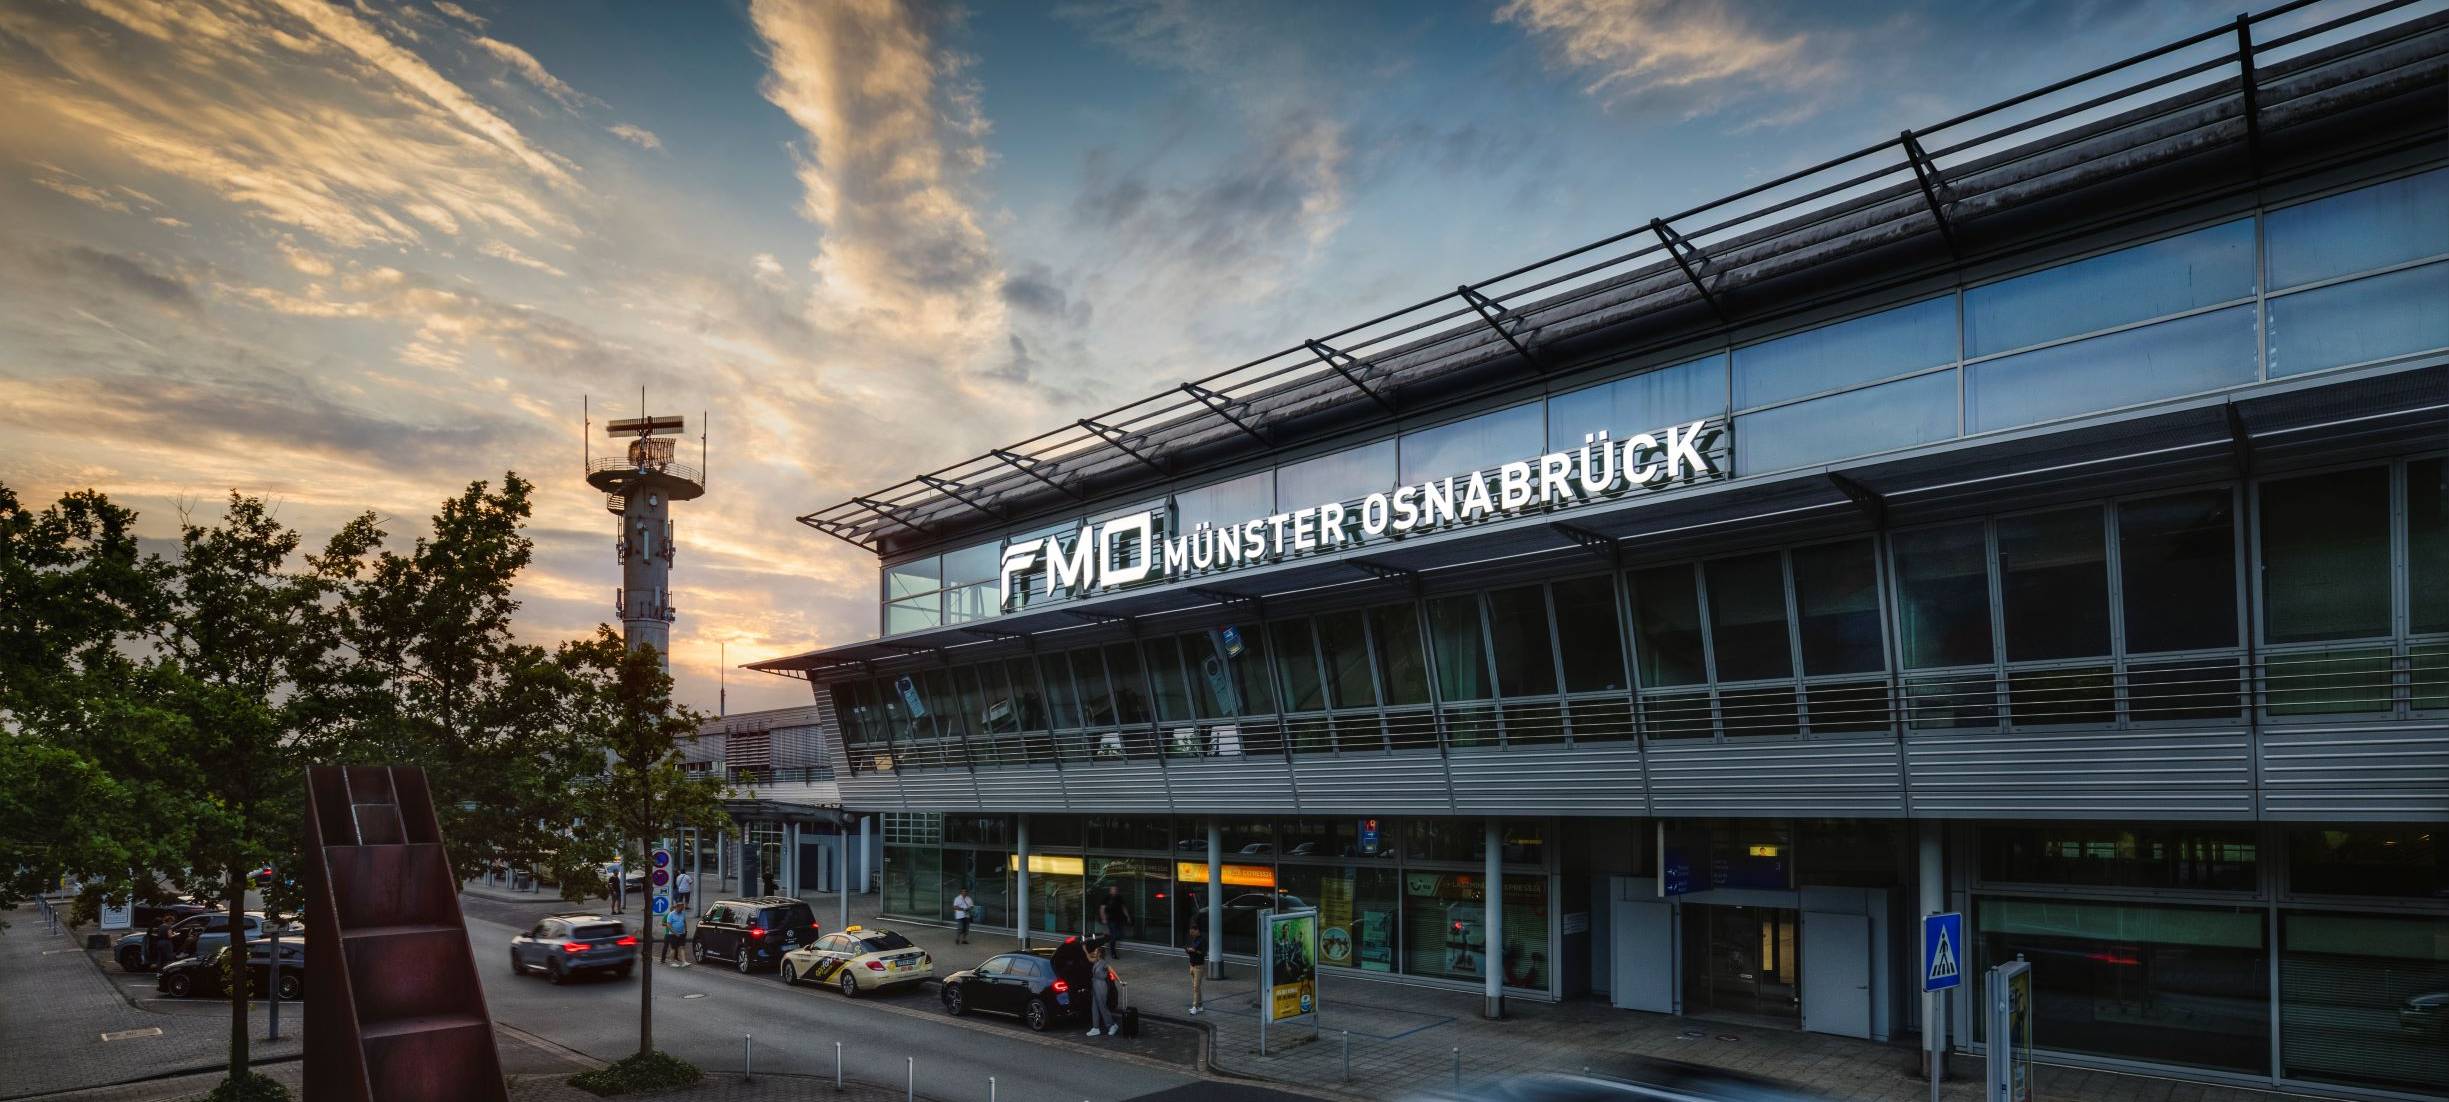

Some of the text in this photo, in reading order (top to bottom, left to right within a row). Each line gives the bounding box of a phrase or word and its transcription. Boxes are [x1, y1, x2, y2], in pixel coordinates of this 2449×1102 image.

[1000, 420, 1708, 607] FMO MÜNSTER OSNABRÜCK
